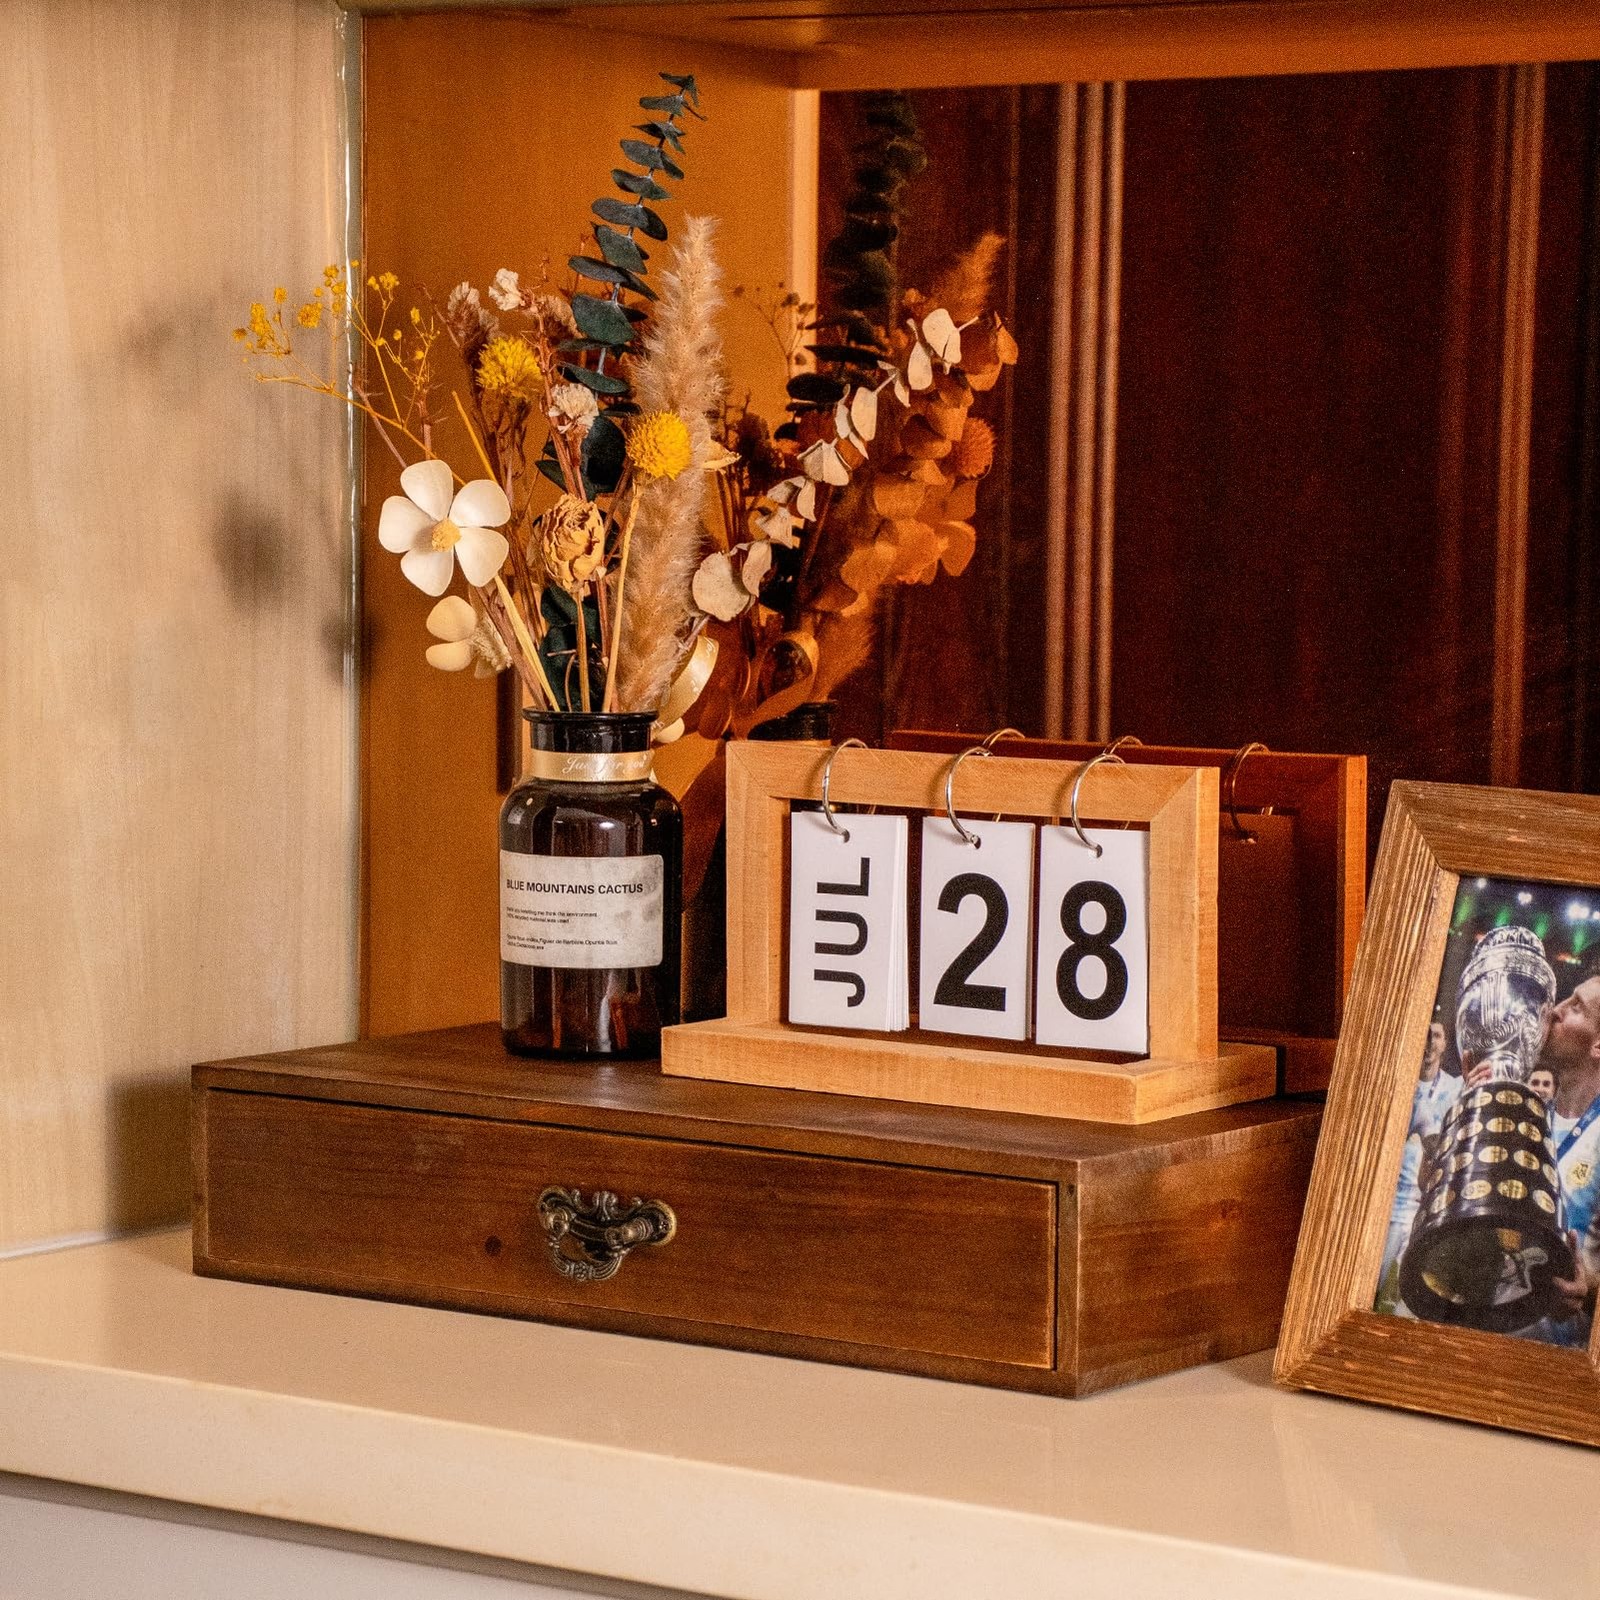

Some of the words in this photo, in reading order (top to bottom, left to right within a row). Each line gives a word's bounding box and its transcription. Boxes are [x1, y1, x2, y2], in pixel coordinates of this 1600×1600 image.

[506, 879, 524, 891] BLUE
[526, 882, 595, 895] MOUNTAINS
[598, 883, 643, 894] CACTUS
[813, 857, 871, 1008] JUL
